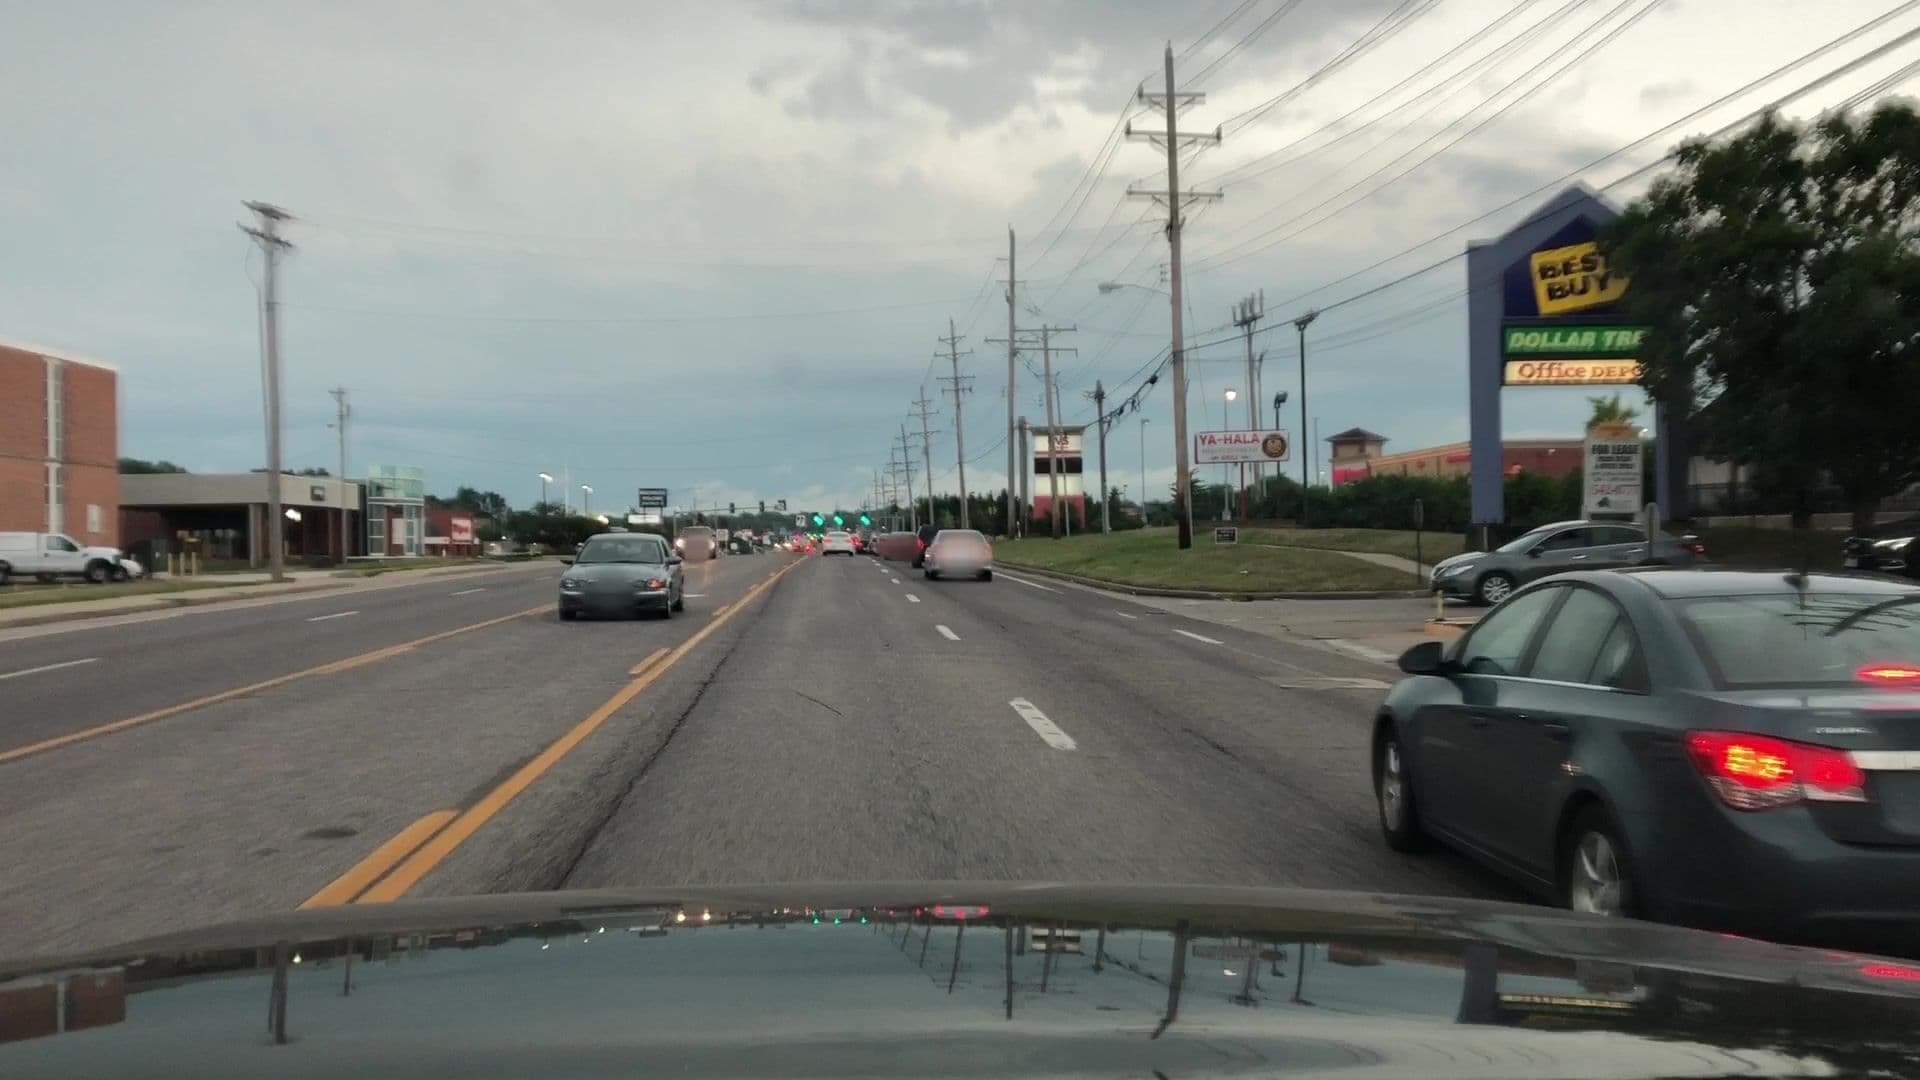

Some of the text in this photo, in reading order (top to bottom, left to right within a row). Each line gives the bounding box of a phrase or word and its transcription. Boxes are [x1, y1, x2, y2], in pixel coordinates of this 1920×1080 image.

[1539, 252, 1599, 280] BES
[1547, 271, 1611, 301] BUY
[1508, 330, 1647, 349] DOLLAR TRE
[1518, 362, 1646, 378] Office DEPO
[1200, 430, 1260, 445] YA-HALA
